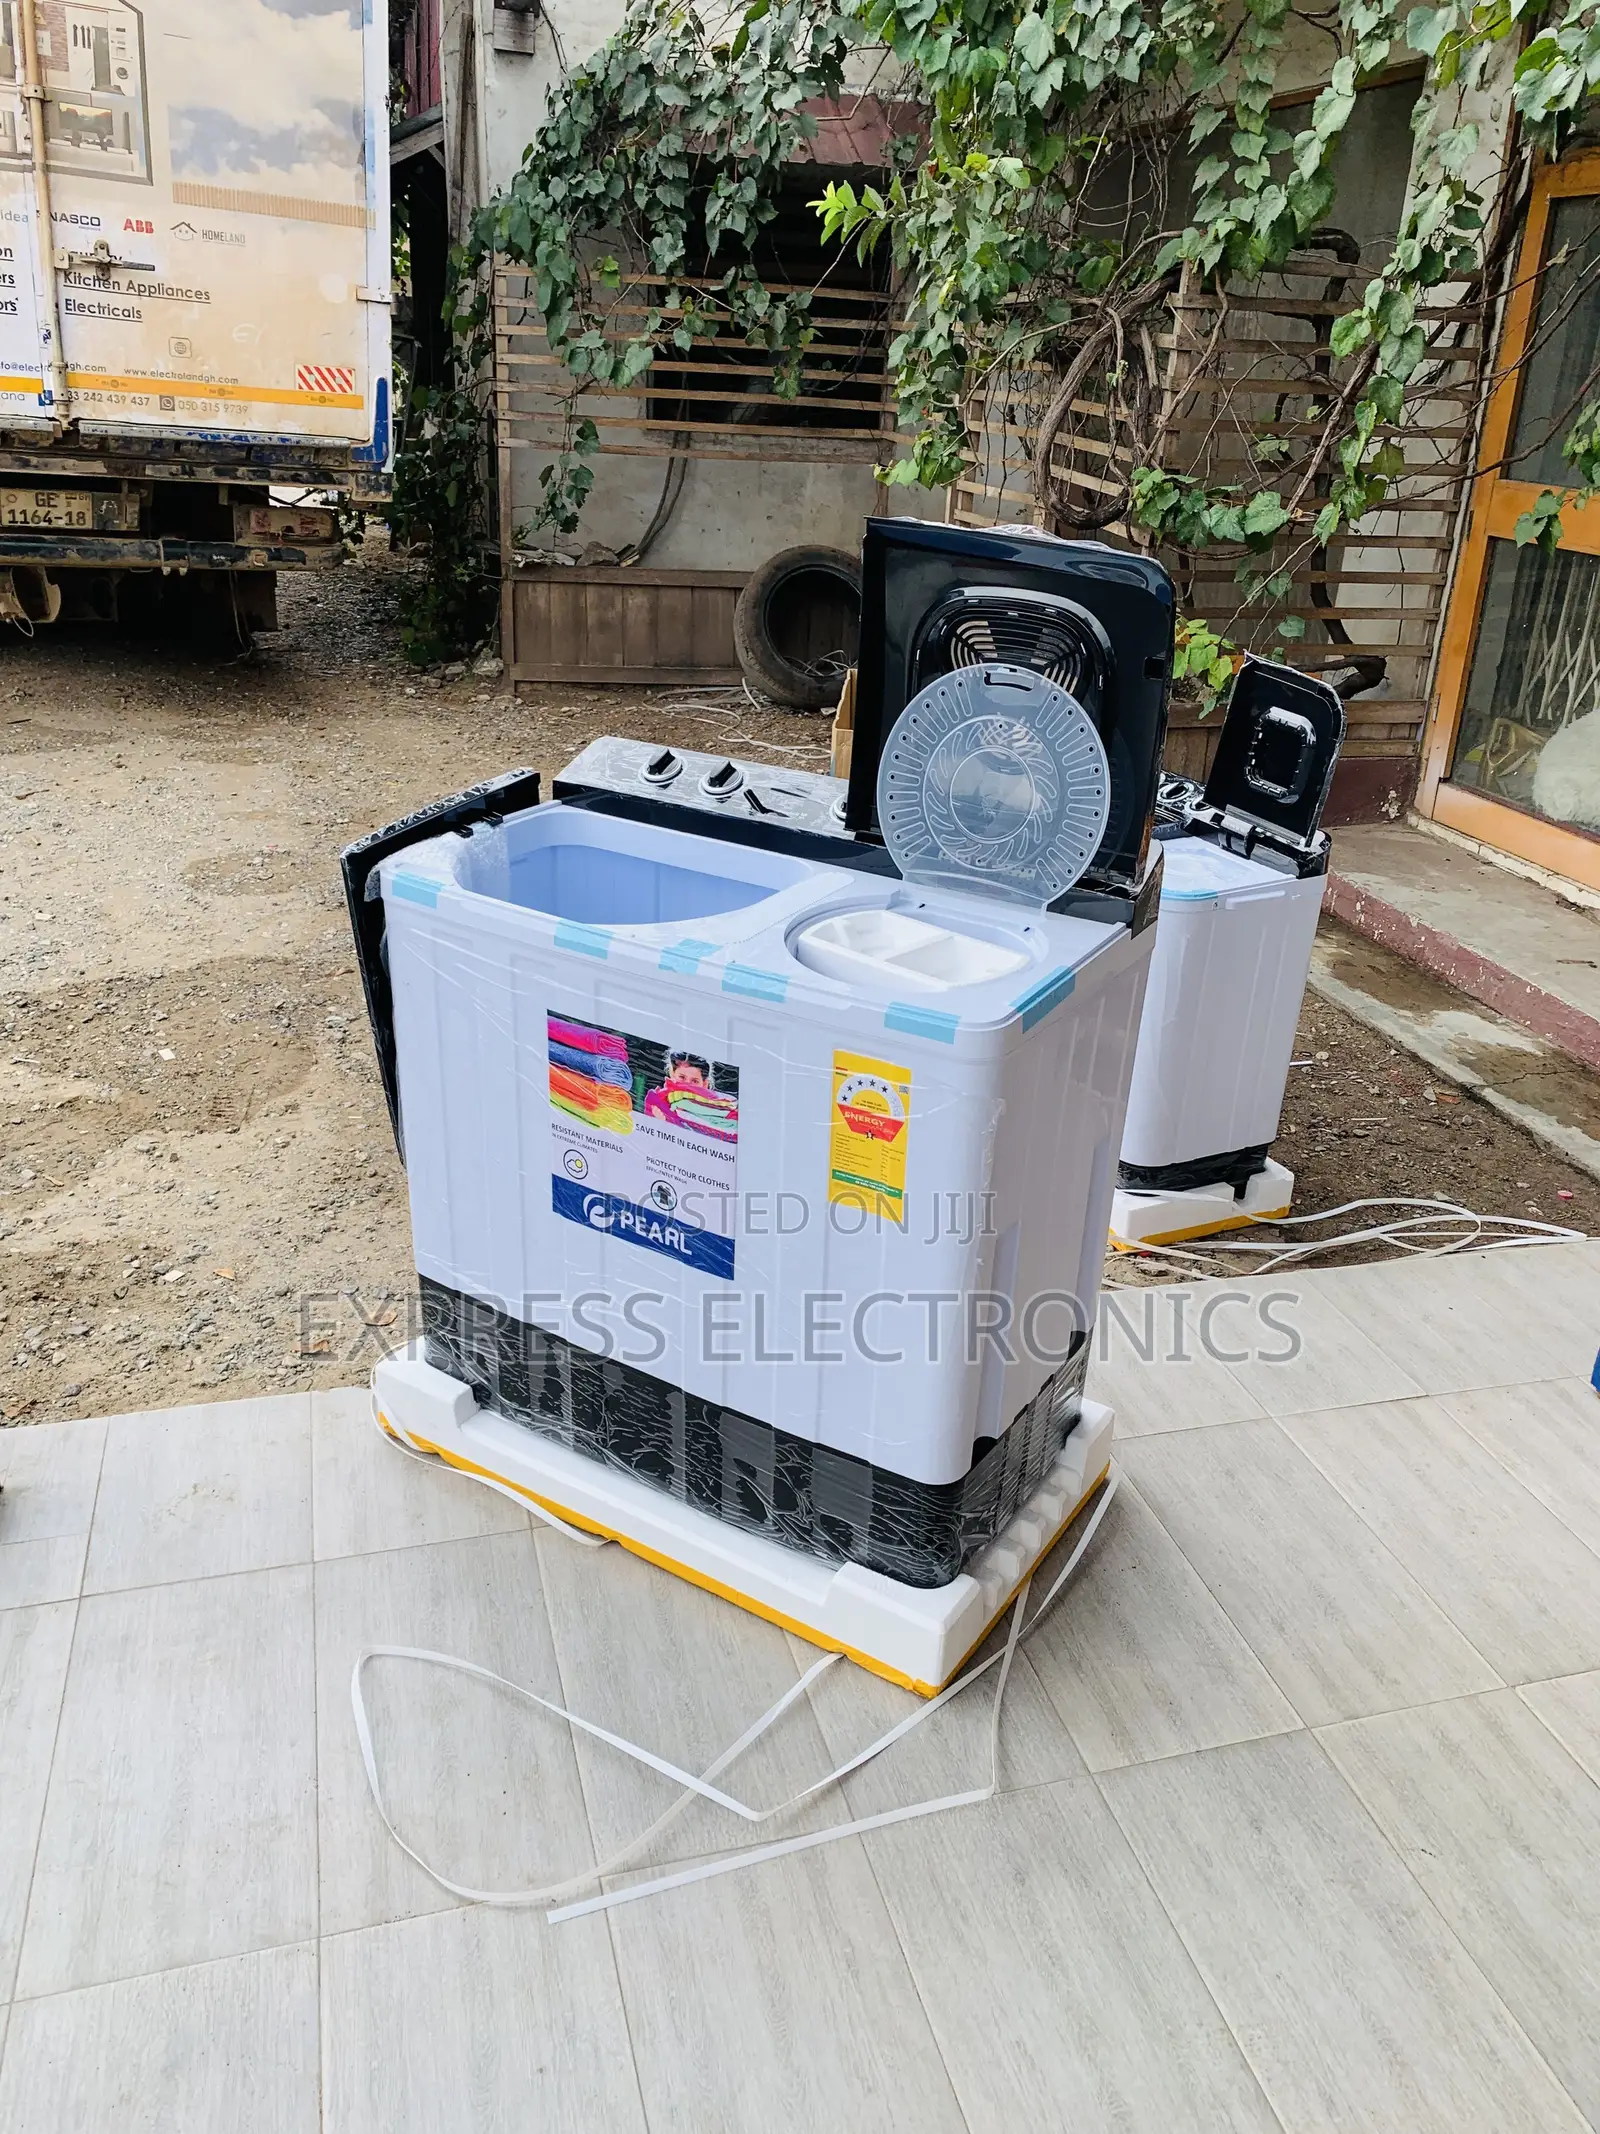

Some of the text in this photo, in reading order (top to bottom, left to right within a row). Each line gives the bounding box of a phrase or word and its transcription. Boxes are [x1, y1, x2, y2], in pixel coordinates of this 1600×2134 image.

[50, 211, 101, 227] NASCO
[123, 218, 155, 234] ABB
[201, 229, 246, 244] HOMELAND
[63, 270, 211, 302] Kitchen Appliances
[65, 298, 143, 320] Electricals
[123, 367, 240, 385] www.electrolandgh.com
[83, 391, 104, 403] 242
[106, 393, 127, 405] 439
[130, 395, 151, 407] 437
[178, 400, 249, 415] 050 315 9739
[35, 491, 59, 508] GE
[7, 508, 87, 527] 1164-18
[844, 1110, 886, 1127] ENERGY
[551, 1122, 624, 1154] RESISTANT MATERIALS
[556, 1135, 577, 1146] EXTREME
[577, 1141, 599, 1154] CLIMATES
[635, 1123, 735, 1163] SAVE TIME IN EACH WASH
[646, 1155, 730, 1191] PROTECT YOUR CLOTHES
[620, 1209, 693, 1256] PEARL
